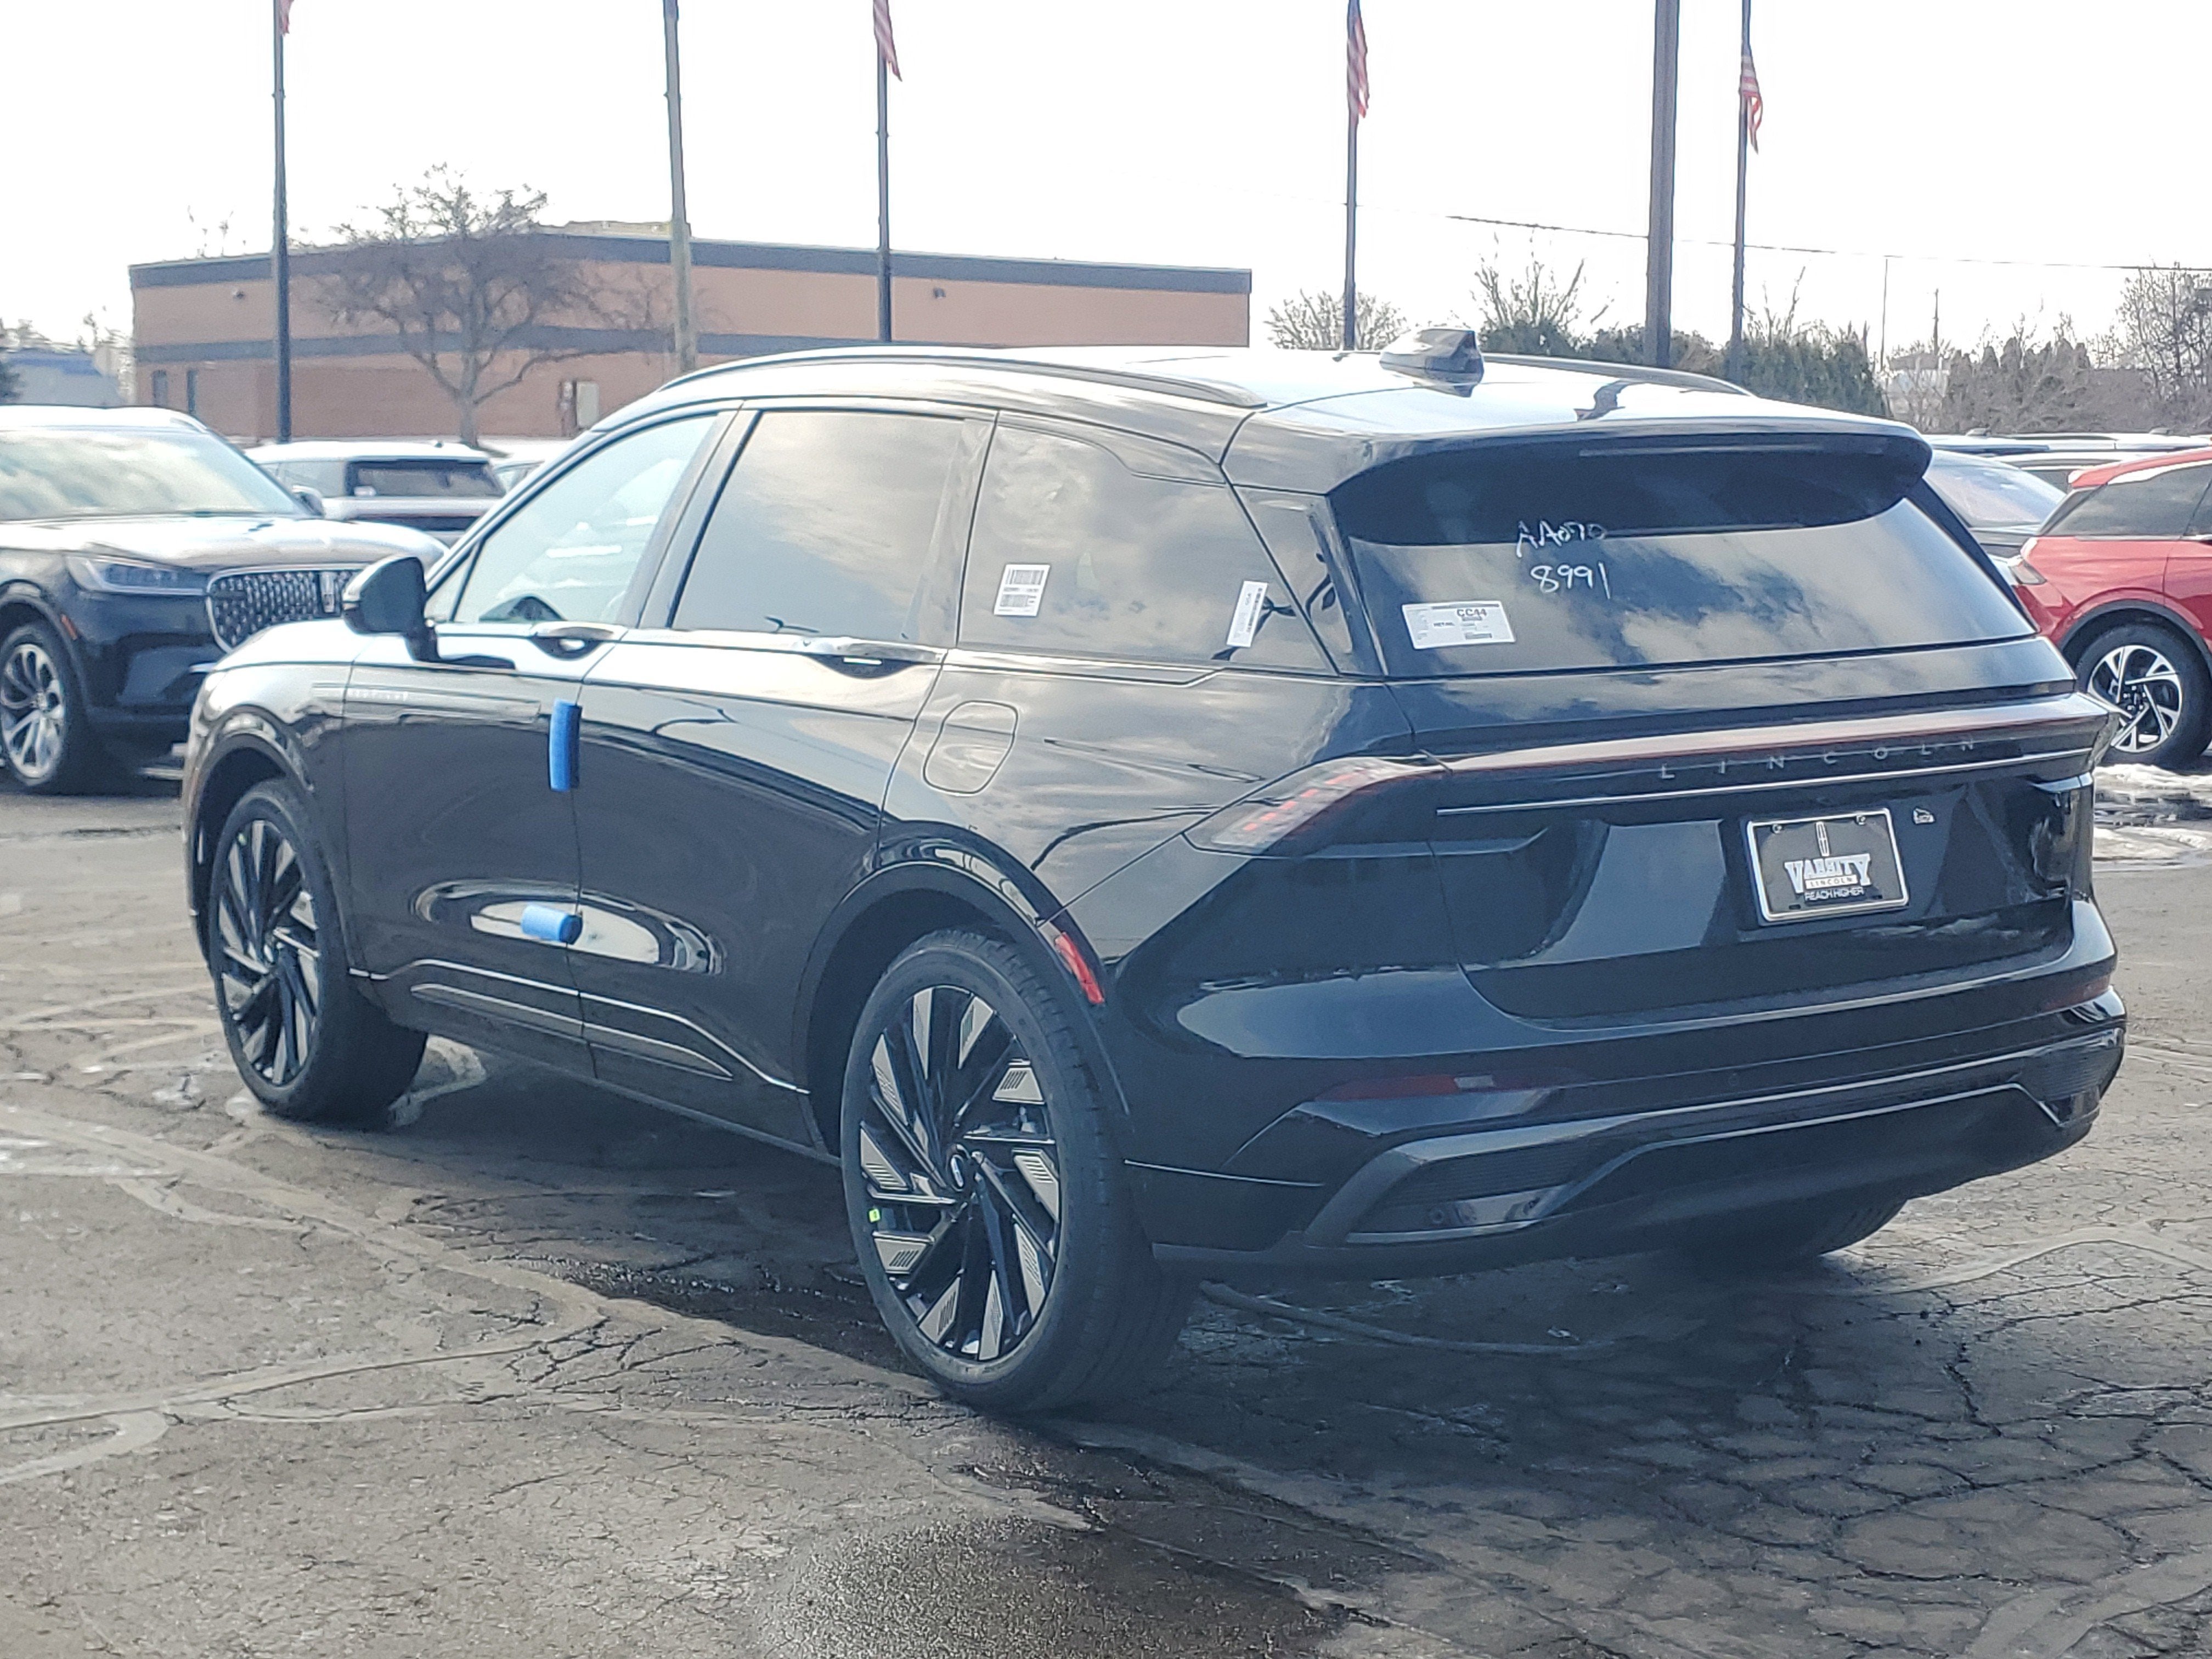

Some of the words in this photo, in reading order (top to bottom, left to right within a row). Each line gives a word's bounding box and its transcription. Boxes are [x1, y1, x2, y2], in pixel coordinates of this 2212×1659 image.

[1530, 562, 1611, 599] 8991
[1661, 740, 1973, 779] LINCOLN
[1784, 853, 1871, 894] VARSITY
[1810, 878, 1853, 887] LINCOLN
[1805, 890, 1833, 901] REACH
[1833, 887, 1864, 898] HIGHER
